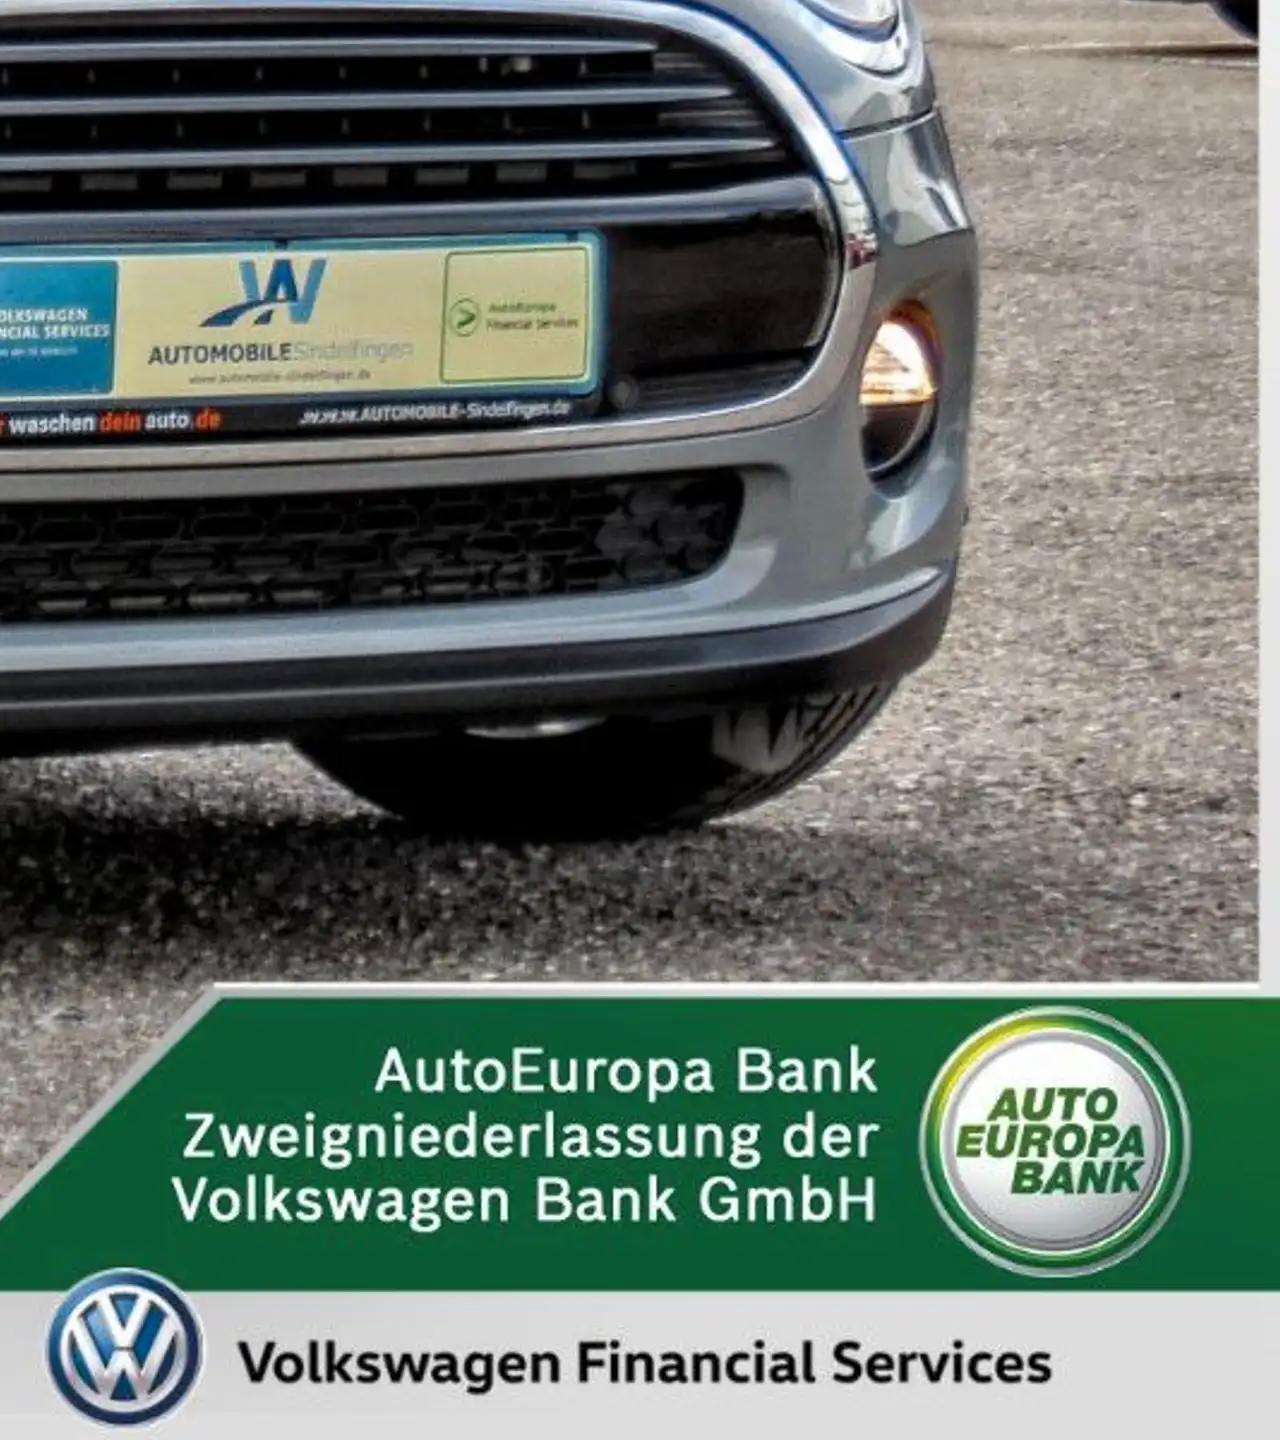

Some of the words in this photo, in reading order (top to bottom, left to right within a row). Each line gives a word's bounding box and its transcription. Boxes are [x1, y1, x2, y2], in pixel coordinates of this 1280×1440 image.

[43, 323, 111, 340] SERVICES
[8, 412, 95, 436] waschen
[99, 409, 141, 433] dein
